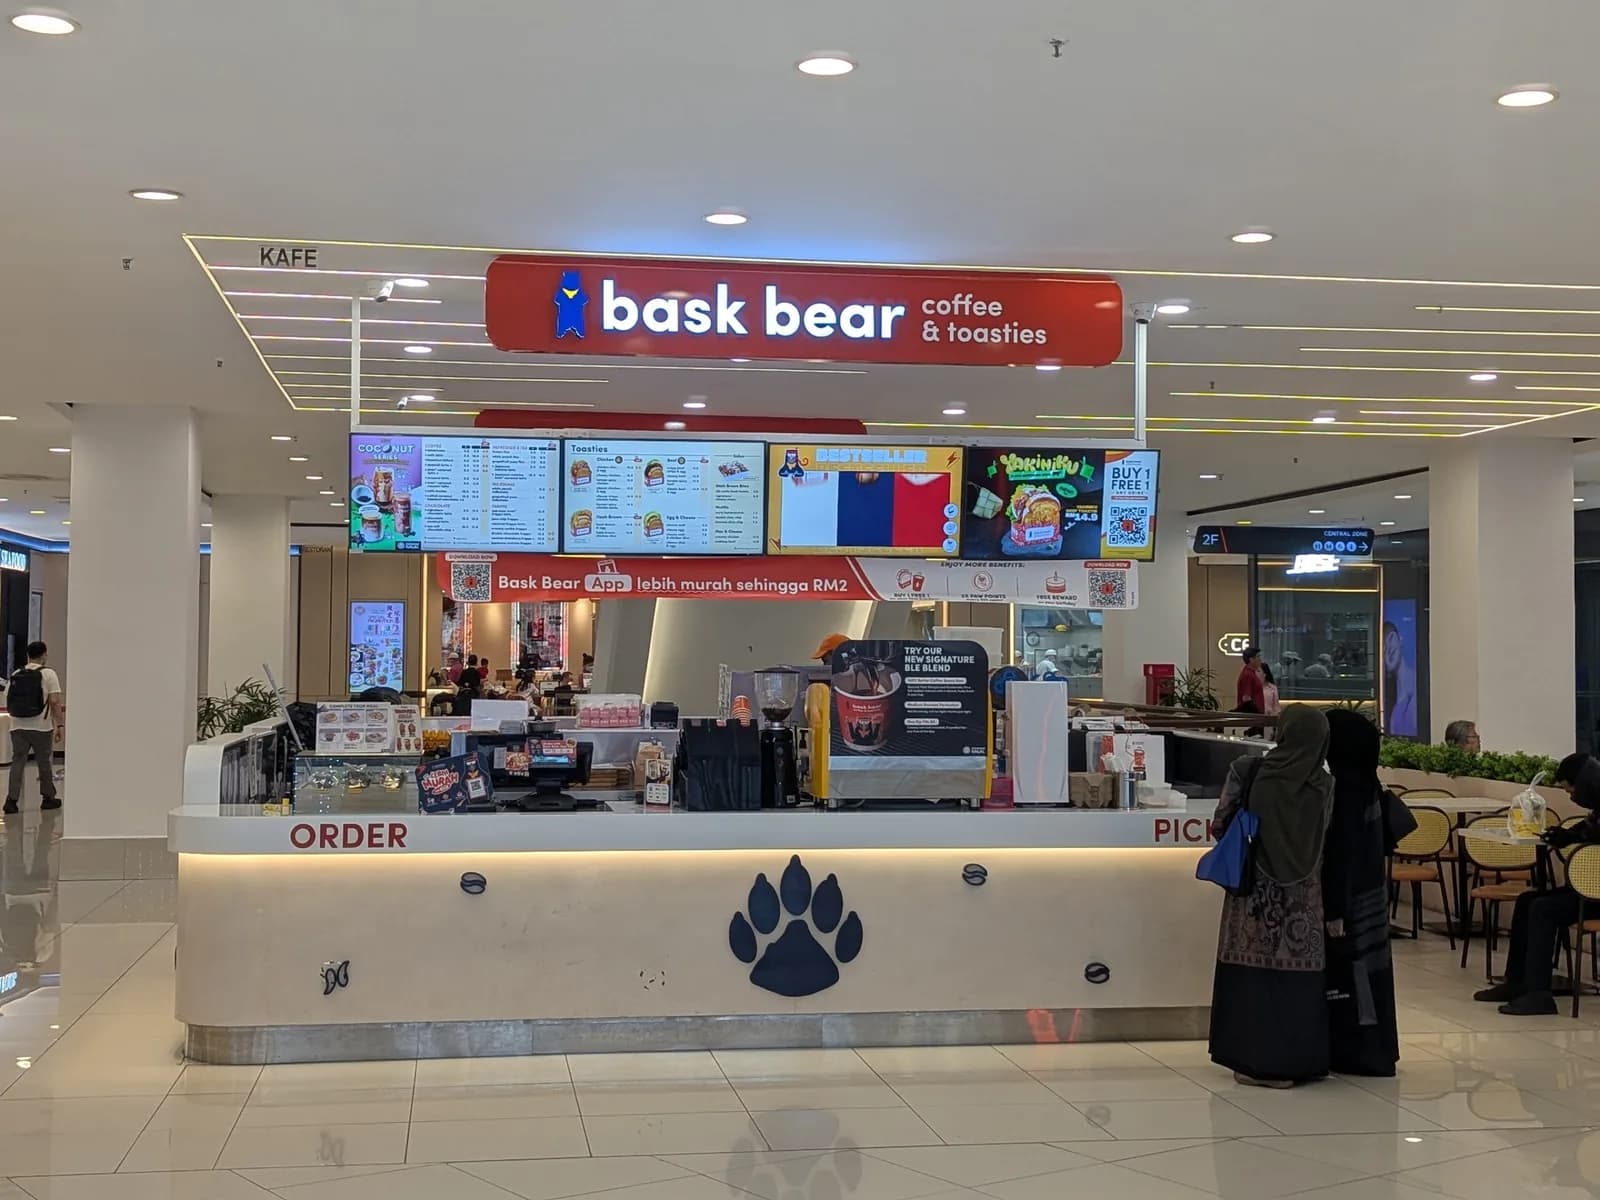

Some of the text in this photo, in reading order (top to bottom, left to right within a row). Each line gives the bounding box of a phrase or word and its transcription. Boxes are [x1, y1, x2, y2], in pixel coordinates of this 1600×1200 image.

[260, 247, 317, 267] KAFE
[603, 279, 905, 339] bask bear
[921, 293, 1003, 316] coffee
[922, 320, 1047, 344] & toasties
[570, 444, 608, 453] Toasties
[815, 448, 927, 464] BESTSELLER
[1000, 453, 1079, 475] YAKINIKU
[1111, 467, 1150, 480] BUY 1
[1111, 480, 1150, 490] FREE 1
[1202, 534, 1219, 545] 2F
[499, 575, 848, 595] Bask Bear App lebih murah sehingga RM2
[904, 646, 942, 655] TRY OUR
[904, 655, 975, 664] NEW SIGNATURE
[922, 664, 951, 672] BLEND
[423, 773, 458, 789] MURAH
[290, 823, 407, 849] ORDER
